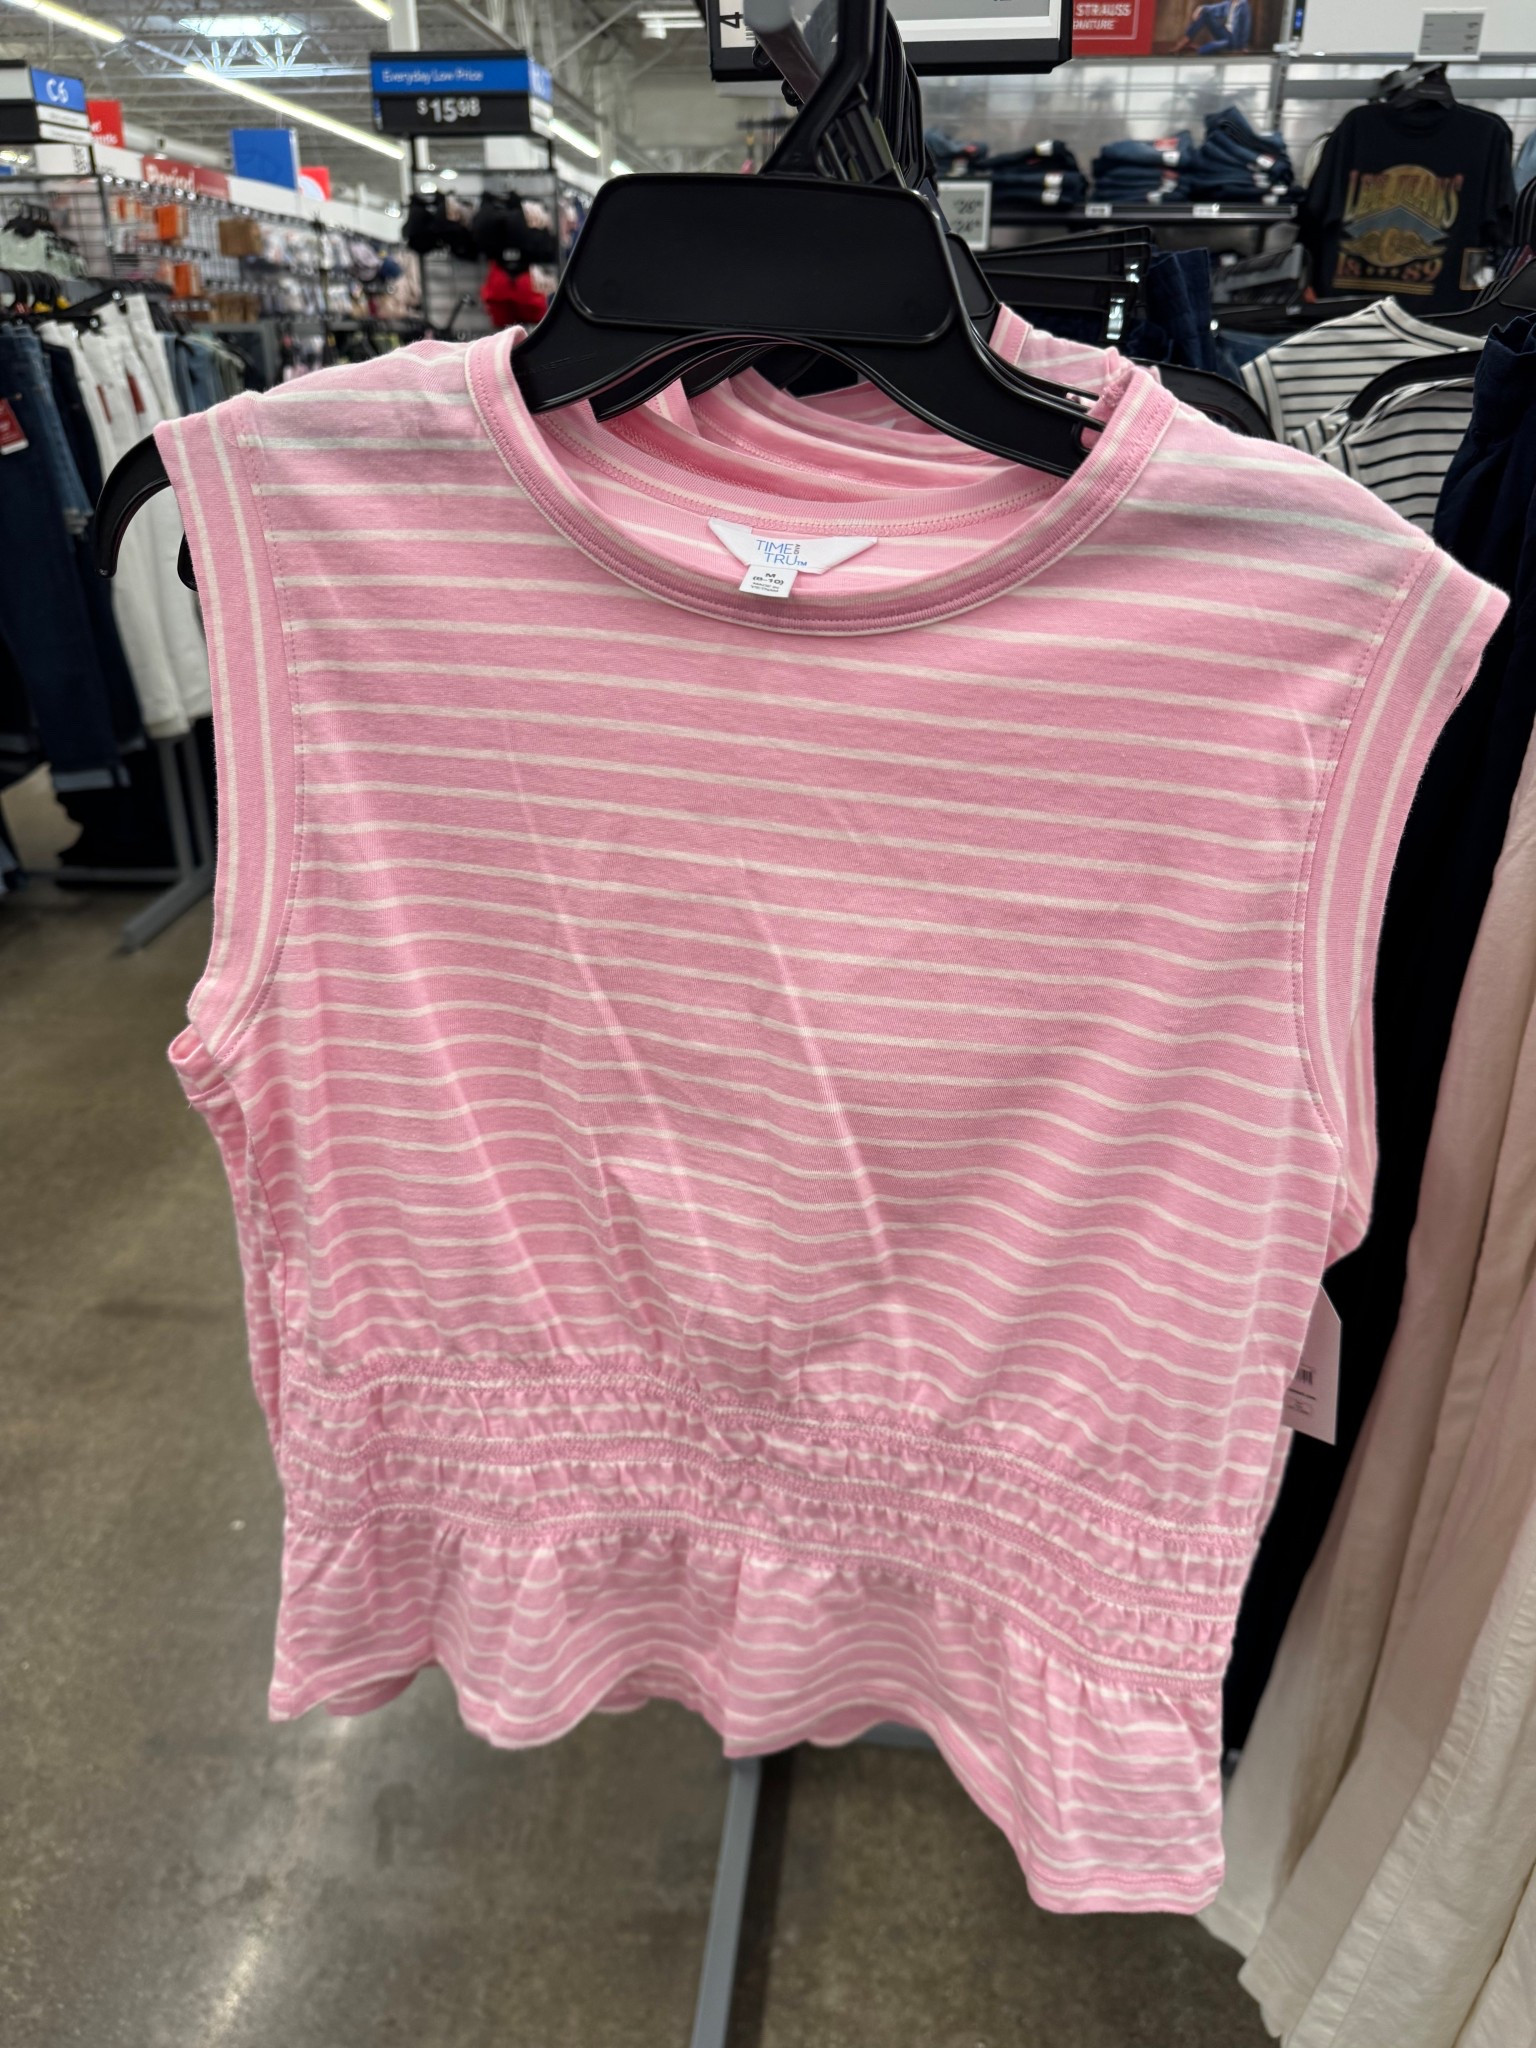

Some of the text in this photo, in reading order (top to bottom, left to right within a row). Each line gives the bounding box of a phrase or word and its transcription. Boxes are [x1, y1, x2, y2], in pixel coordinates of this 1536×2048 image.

[1076, 4, 1132, 17] STRAUSS
[382, 68, 483, 86] Everyday Low Price
[756, 540, 794, 555] TIME
